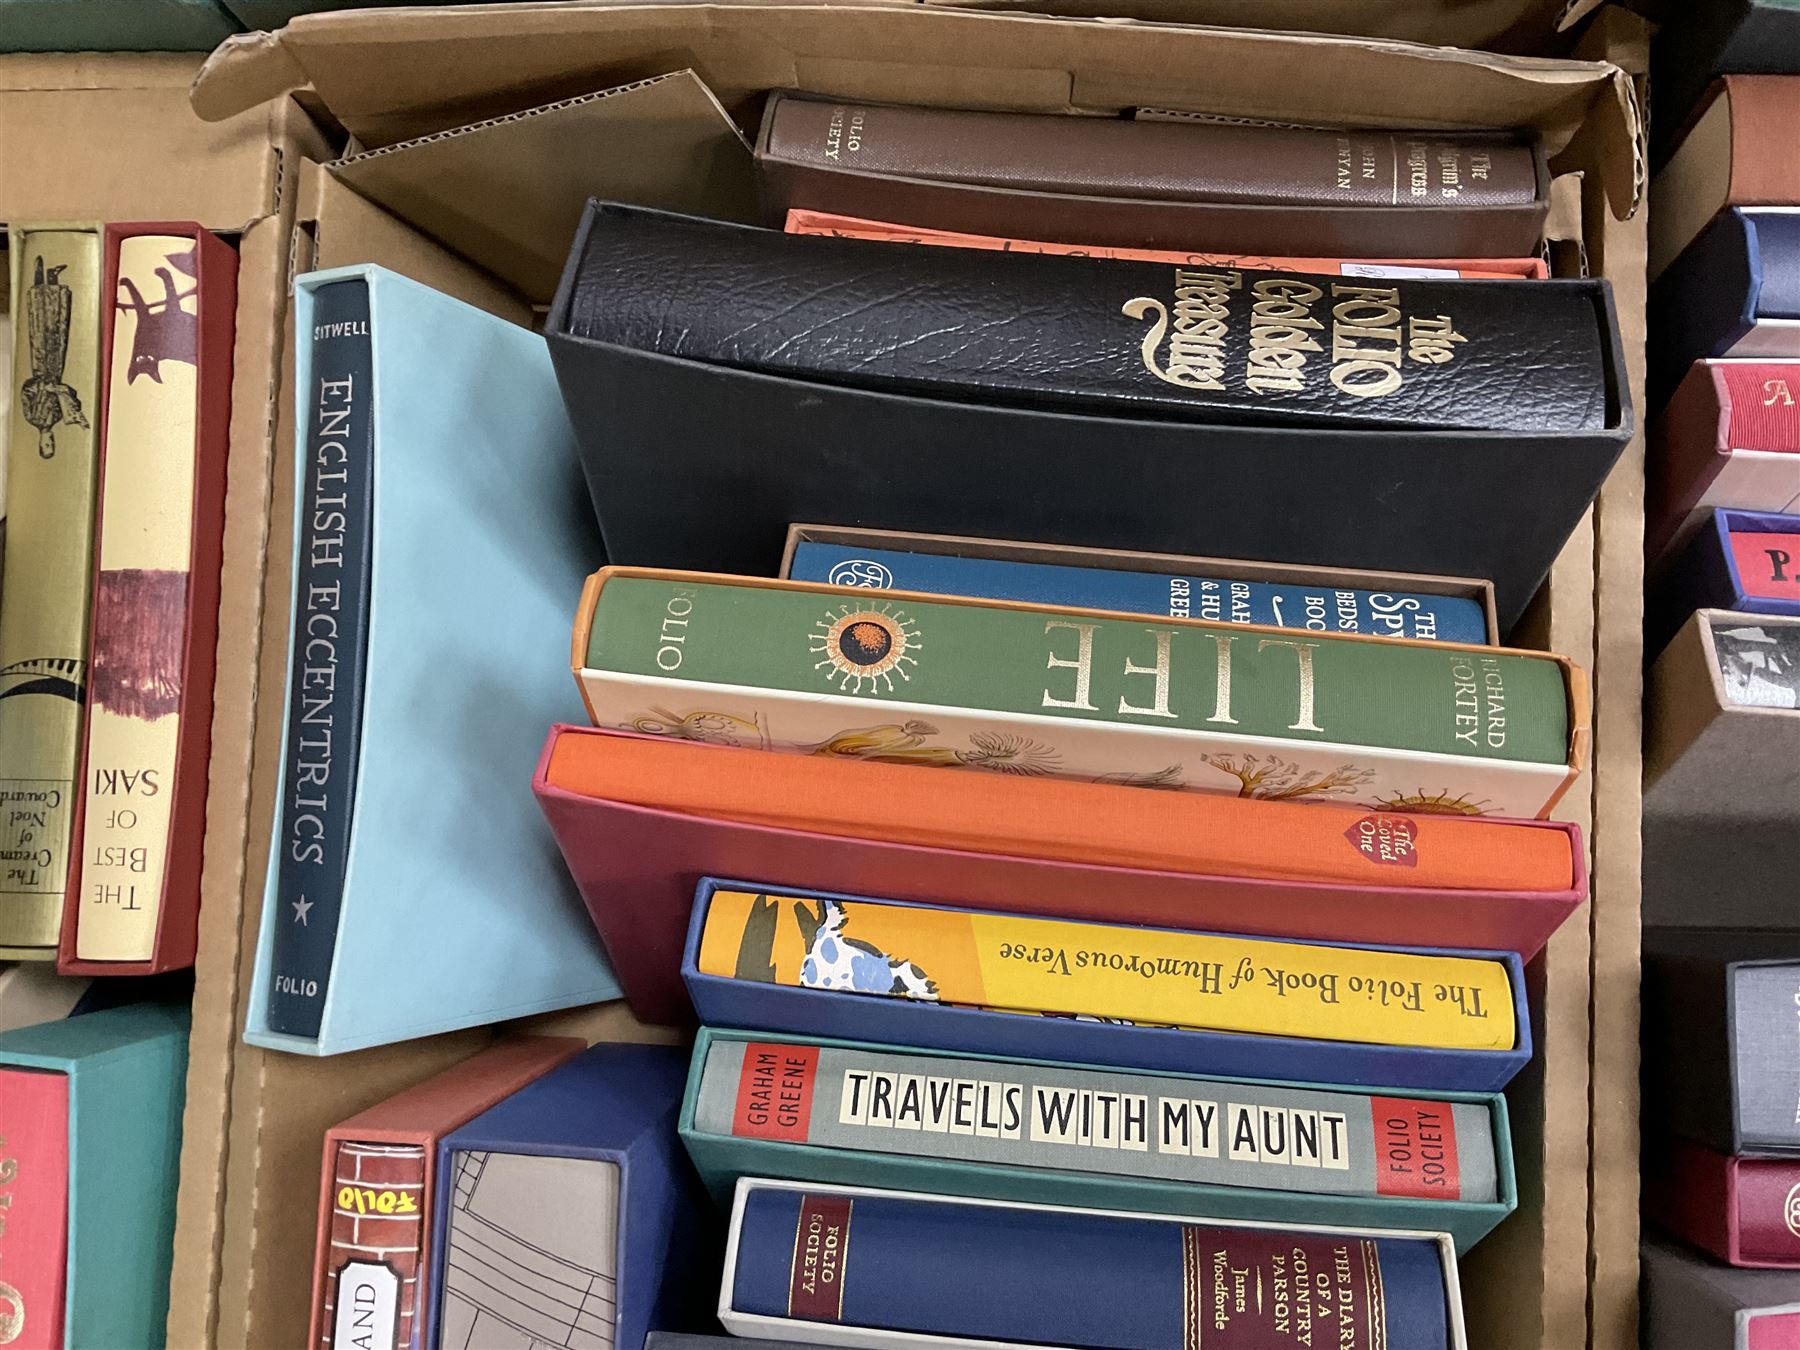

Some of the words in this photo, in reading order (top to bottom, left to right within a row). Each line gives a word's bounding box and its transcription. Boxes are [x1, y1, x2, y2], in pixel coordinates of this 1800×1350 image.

[825, 106, 845, 160] OCIETY
[313, 320, 371, 341] SITWELL
[1121, 268, 1243, 391] Treasury
[1245, 279, 1325, 395] Golden
[1330, 282, 1402, 397] FOLIO
[1408, 314, 1468, 364] The
[311, 373, 353, 568] ENGLISH
[1170, 578, 1190, 619] GREE
[1201, 581, 1220, 590] &
[1230, 582, 1250, 624] GRAH
[657, 587, 697, 671] FOLIO
[1201, 595, 1220, 621] HU
[1335, 591, 1358, 633] BEDS
[1415, 612, 1437, 640] TH
[1041, 620, 1326, 733] LIFE
[291, 579, 341, 865] ECCENTRICS
[1450, 656, 1478, 748] FORTEY
[1480, 659, 1506, 748] RICHARD
[95, 768, 160, 796] SAKI
[9, 811, 47, 828] Noel
[16, 828, 34, 848] of
[106, 809, 138, 829] OF
[1359, 820, 1376, 852] One
[1377, 815, 1398, 861] Loved
[1392, 824, 1415, 856] The
[7, 868, 40, 886] The
[93, 847, 148, 873] BEST
[93, 884, 142, 910] THE
[1000, 943, 1072, 976] Verse
[1075, 950, 1224, 995] Humorous
[1228, 957, 1255, 990] of
[275, 975, 317, 997] FOLIO
[1260, 967, 1340, 1004] Book
[1348, 976, 1425, 1012] Folio
[1435, 984, 1488, 1018] The
[747, 1053, 778, 1126] GRAHAM
[778, 1057, 807, 1127] GREENE
[848, 1074, 1021, 1132] TRAVELS
[1036, 1090, 1147, 1143] WITH
[1163, 1101, 1215, 1149] MY
[1233, 1108, 1344, 1160] AUNT
[1386, 1119, 1412, 1172] FOLIO
[1417, 1111, 1446, 1186] SOCIETY
[802, 1213, 824, 1295] SOCIETY
[821, 1225, 840, 1283] FOLIO
[1333, 1246, 1351, 1284] THE
[1213, 1250, 1231, 1330] Woodforde
[1231, 1267, 1249, 1313] James
[1272, 1255, 1290, 1334] PARSON
[1292, 1247, 1312, 1347] COUNTRY
[1316, 1273, 1332, 1300] OF
[1318, 1304, 1332, 1317] A
